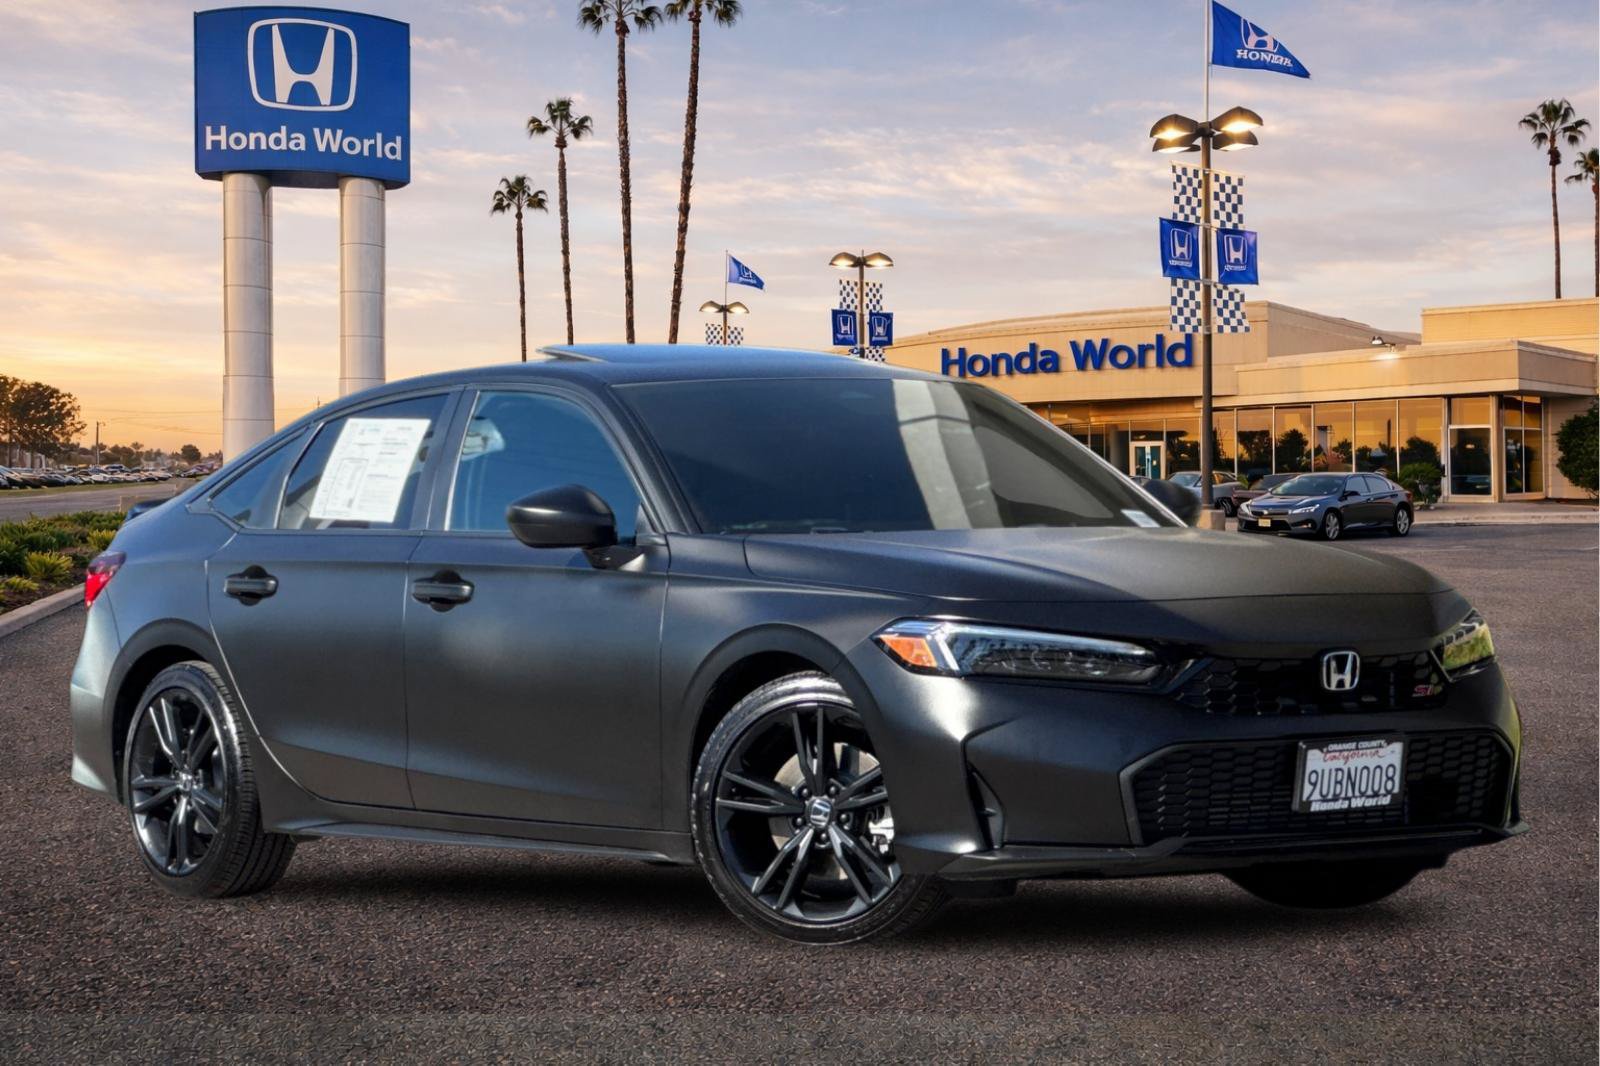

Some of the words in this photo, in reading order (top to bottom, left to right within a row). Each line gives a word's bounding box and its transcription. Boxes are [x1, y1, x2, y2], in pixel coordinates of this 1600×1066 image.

[205, 125, 305, 151] Honda
[313, 127, 402, 161] World
[941, 342, 1060, 377] Honda
[1070, 333, 1194, 371] World
[1322, 749, 1385, 765] California
[1358, 740, 1385, 748] COUNTY
[1306, 763, 1396, 801] 9UBN008
[1310, 799, 1349, 812] Honda
[1350, 795, 1392, 808] World
